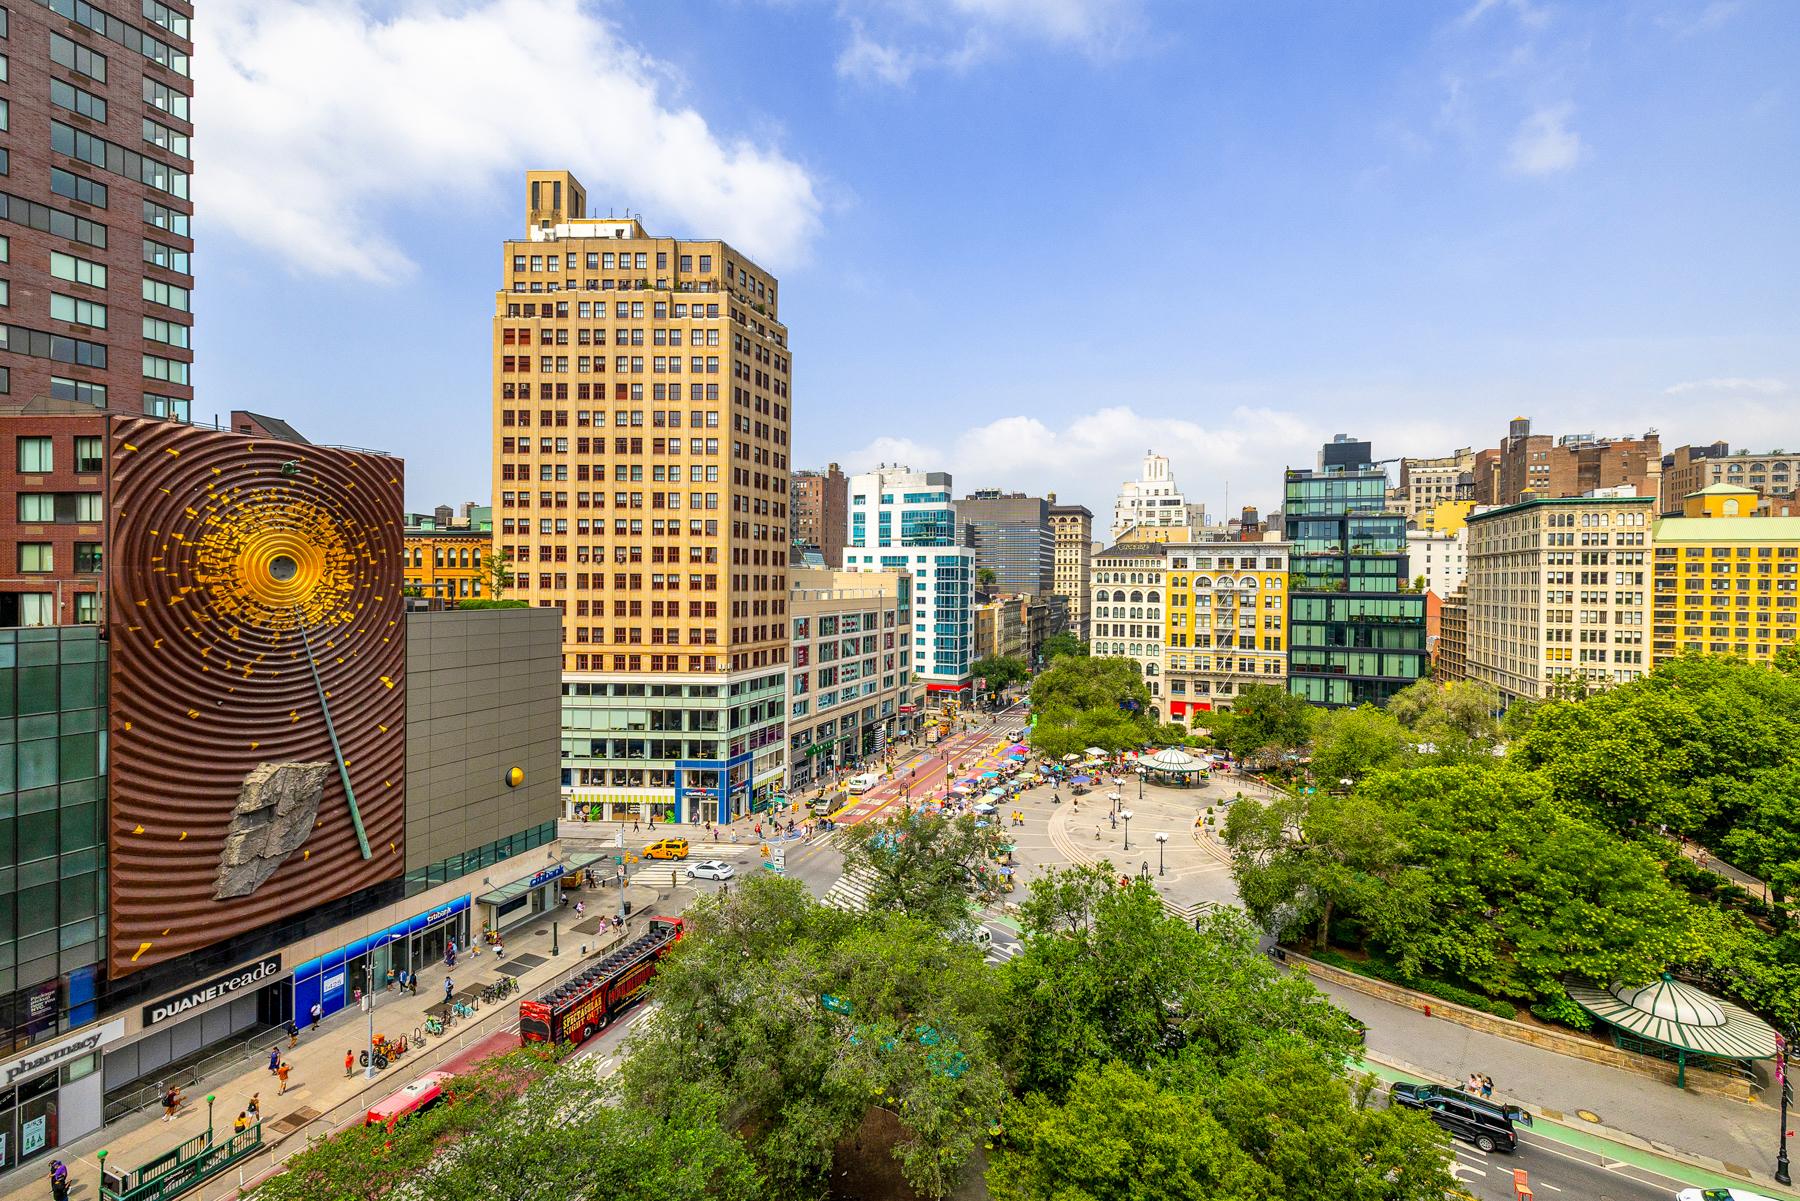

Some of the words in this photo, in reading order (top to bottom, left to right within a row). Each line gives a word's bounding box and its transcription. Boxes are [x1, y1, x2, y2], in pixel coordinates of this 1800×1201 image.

[530, 865, 564, 887] citibank
[427, 906, 452, 922] citibank
[563, 996, 602, 1030] SPECTACULAR
[563, 1017, 585, 1038] NIGHT
[6, 1032, 102, 1085] pharmacy
